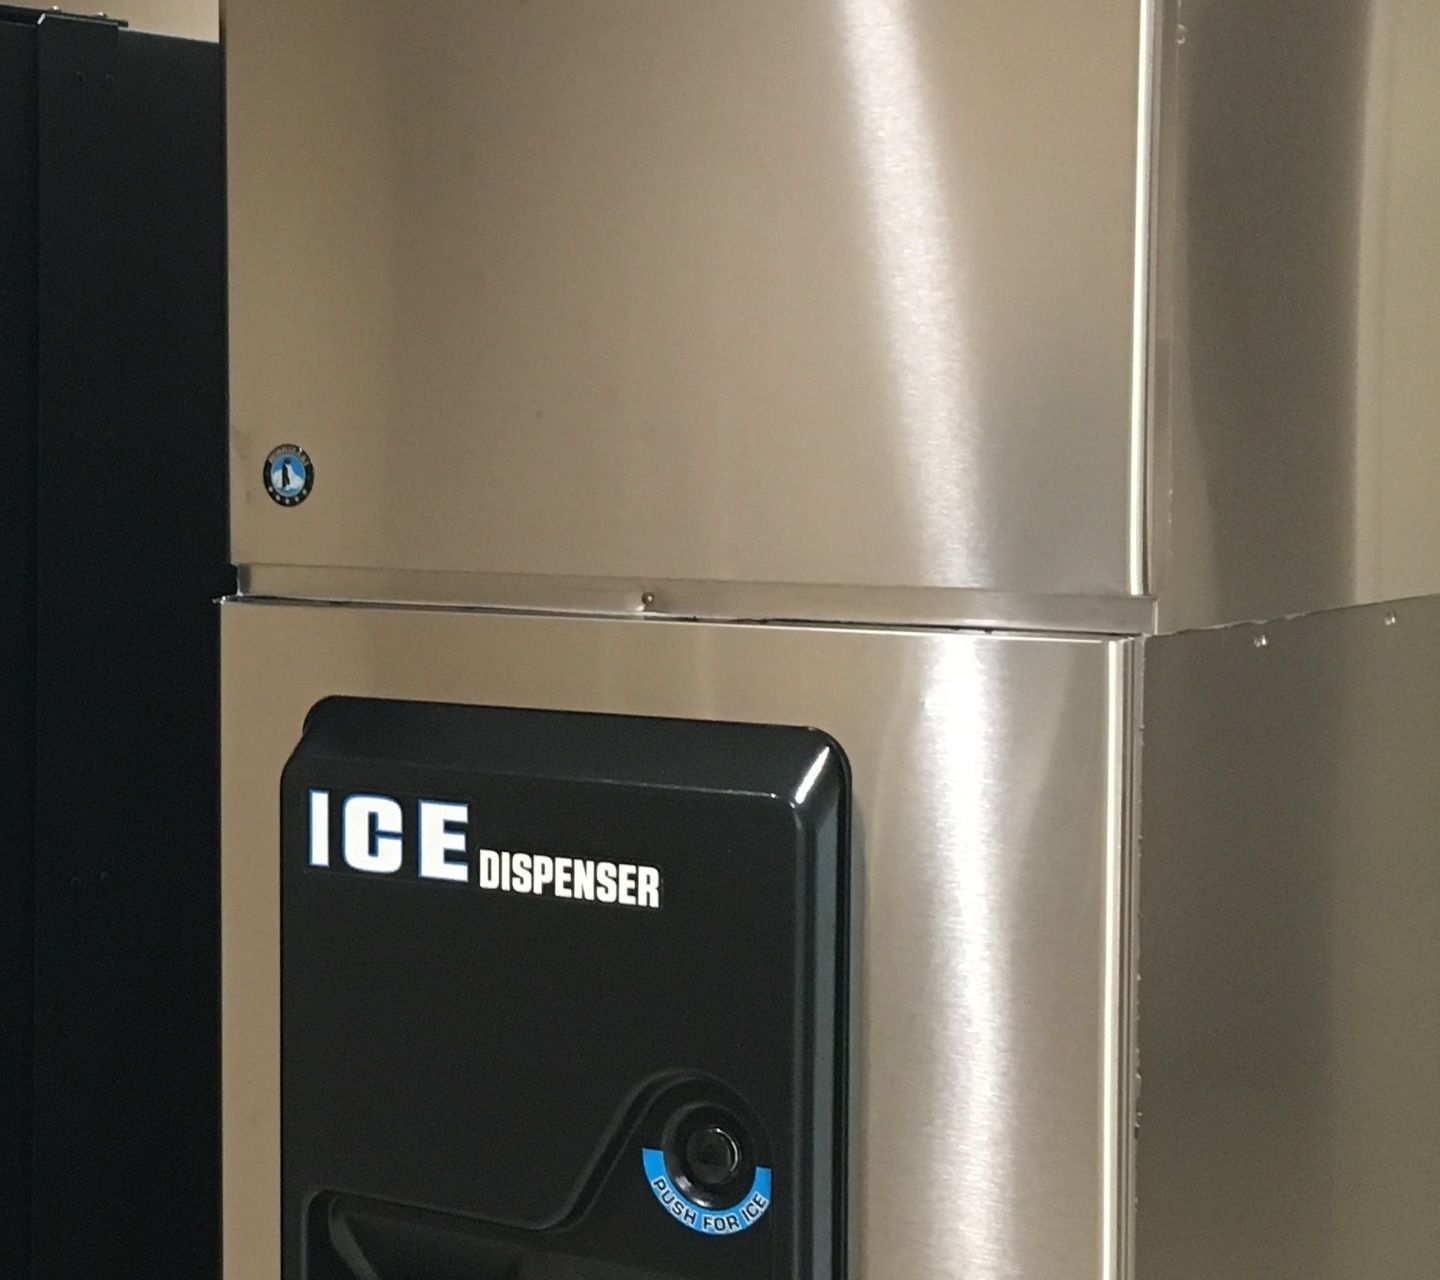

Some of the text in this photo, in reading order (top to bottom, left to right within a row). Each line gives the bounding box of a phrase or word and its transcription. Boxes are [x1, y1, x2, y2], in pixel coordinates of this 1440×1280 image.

[309, 789, 660, 909] ICE DISPENSER
[653, 1178, 767, 1232] PUSH FOR ICE
